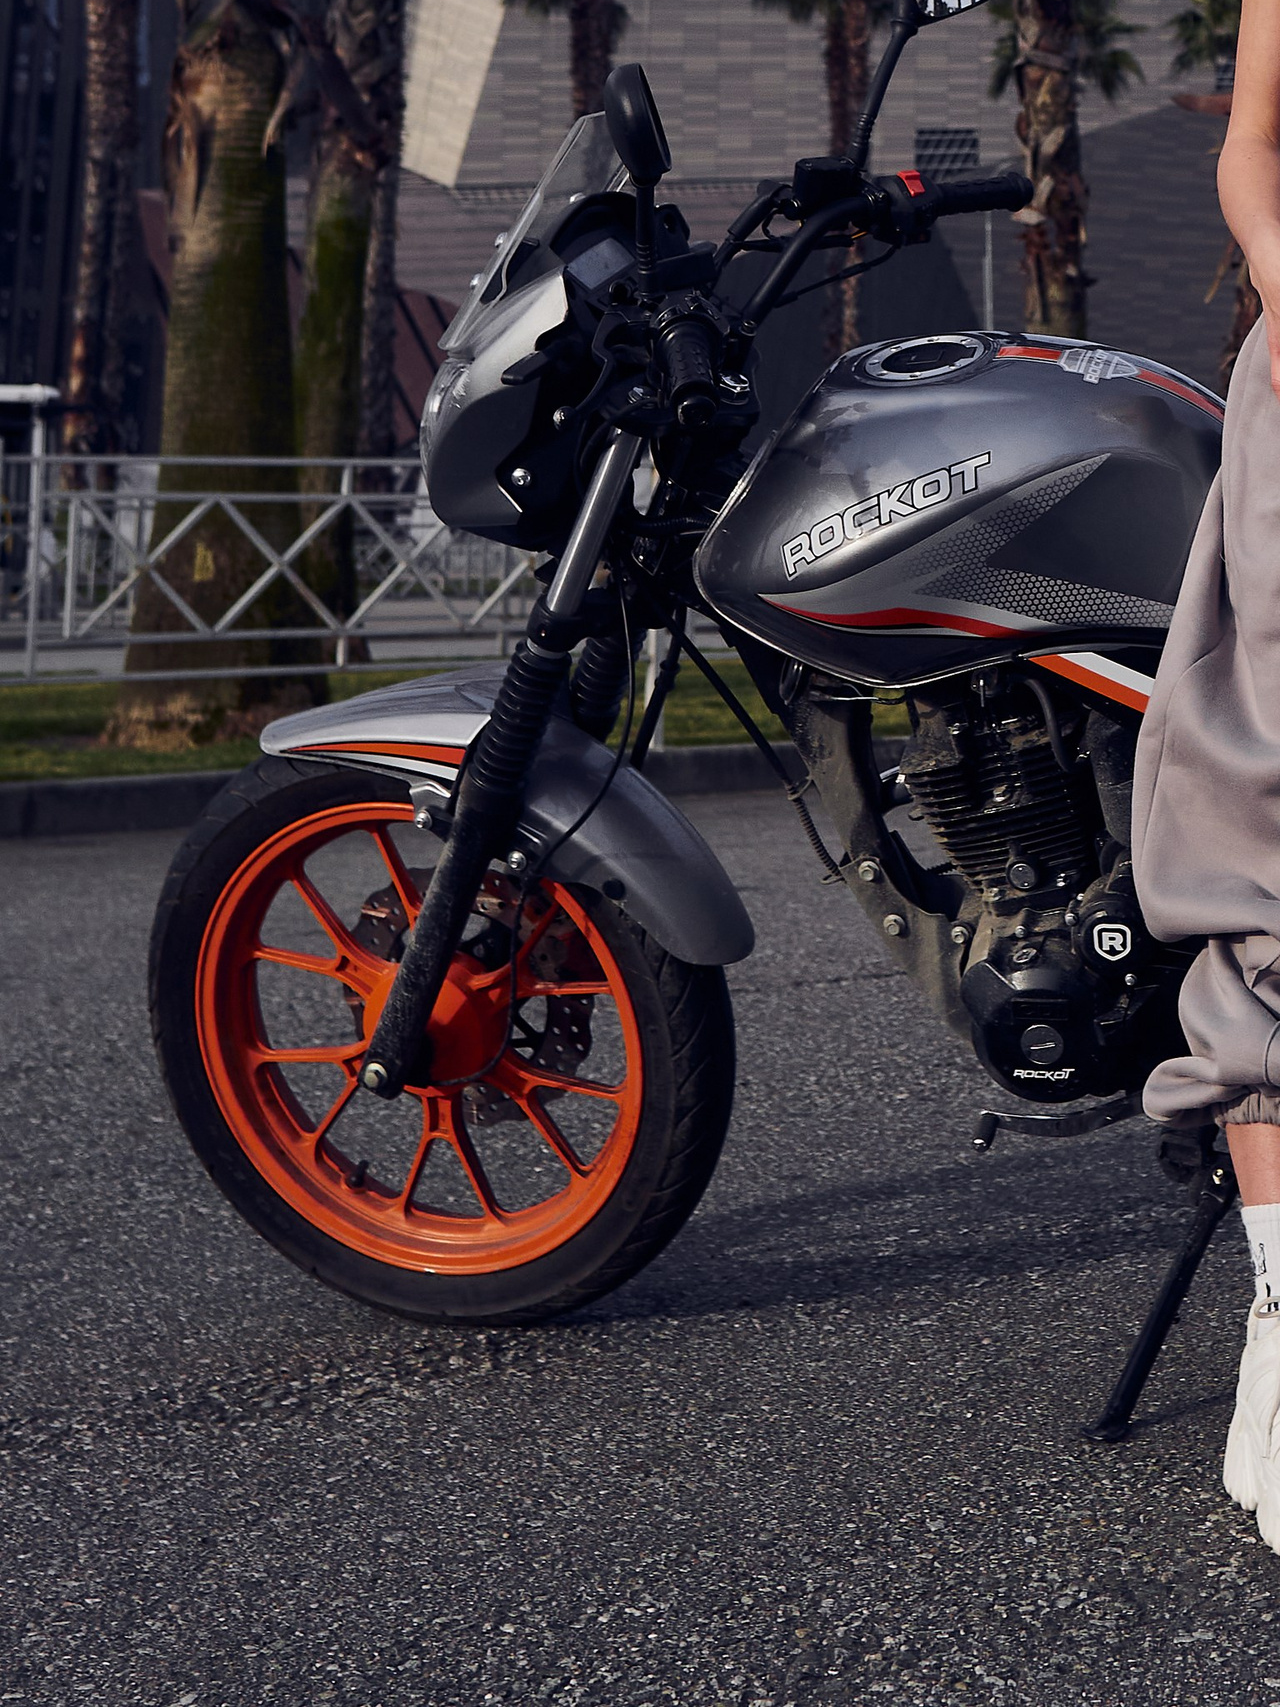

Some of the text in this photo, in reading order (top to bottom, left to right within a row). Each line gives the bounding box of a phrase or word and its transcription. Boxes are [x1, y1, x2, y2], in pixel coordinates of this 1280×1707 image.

[781, 450, 991, 580] ROCKOT
[1101, 931, 1125, 951] R
[1012, 1067, 1076, 1082] ROCKOT
